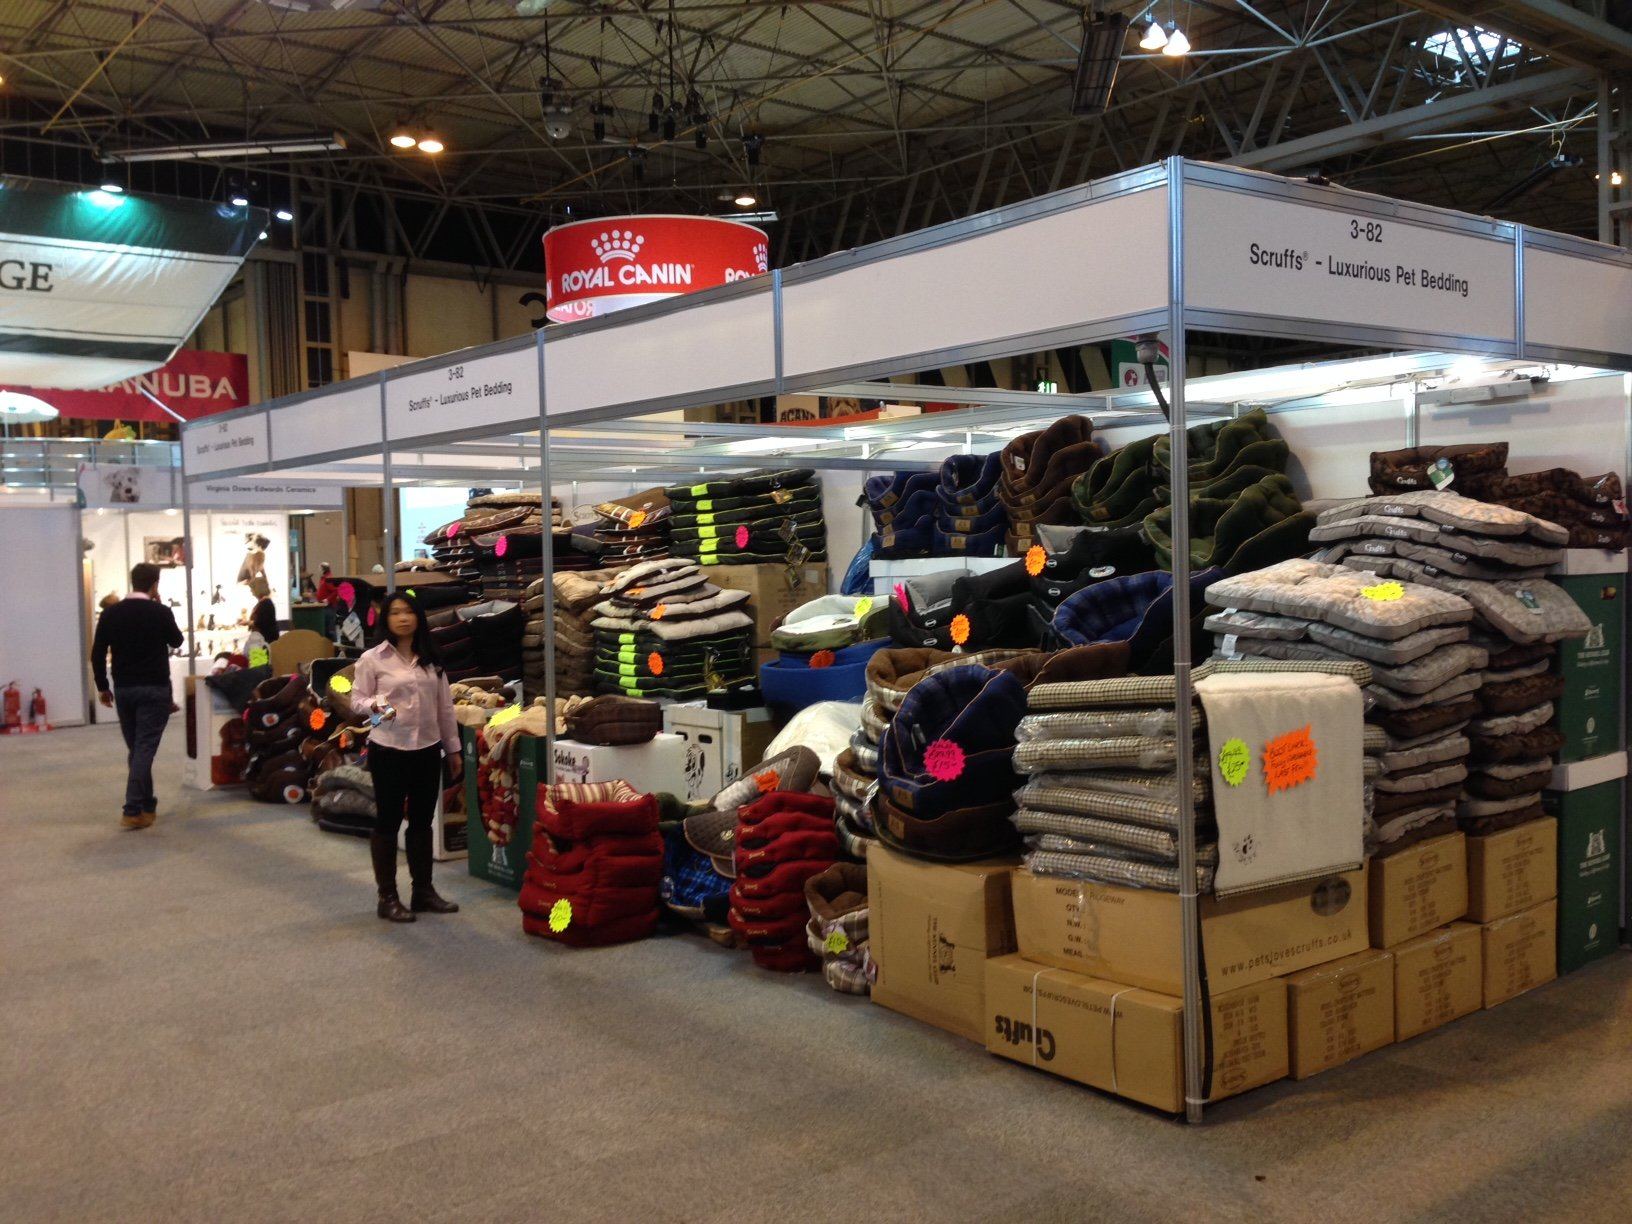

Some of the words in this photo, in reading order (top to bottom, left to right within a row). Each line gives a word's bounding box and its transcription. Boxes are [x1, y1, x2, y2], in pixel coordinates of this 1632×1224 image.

[1351, 220, 1382, 243] 3-82
[562, 267, 614, 293] ROYAL
[1328, 255, 1391, 283] Luxurious
[1396, 266, 1416, 286] Pet
[1421, 269, 1468, 297] Bedding
[448, 366, 464, 380] 3-82
[440, 390, 469, 405] Luxurious
[471, 387, 482, 399] Pet
[484, 382, 512, 395] Bedding
